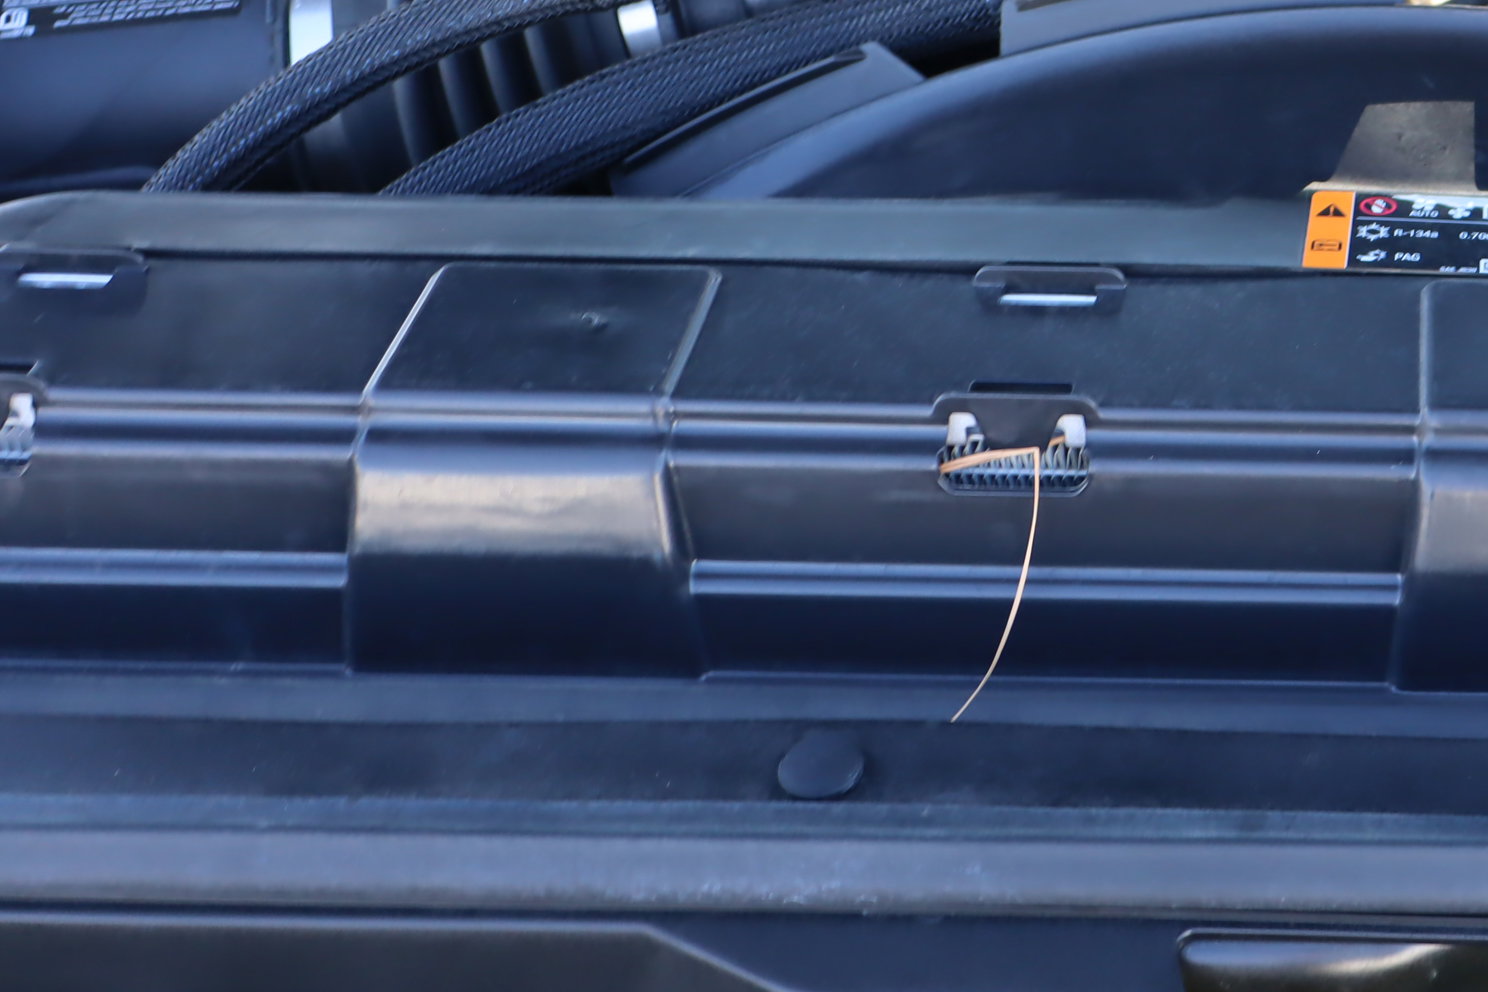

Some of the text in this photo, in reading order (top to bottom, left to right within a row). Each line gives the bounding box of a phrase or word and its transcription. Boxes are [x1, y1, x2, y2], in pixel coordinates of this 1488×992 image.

[1409, 210, 1439, 218] AUTO
[1393, 229, 1439, 239] R-134a
[1394, 251, 1421, 263] PAG
